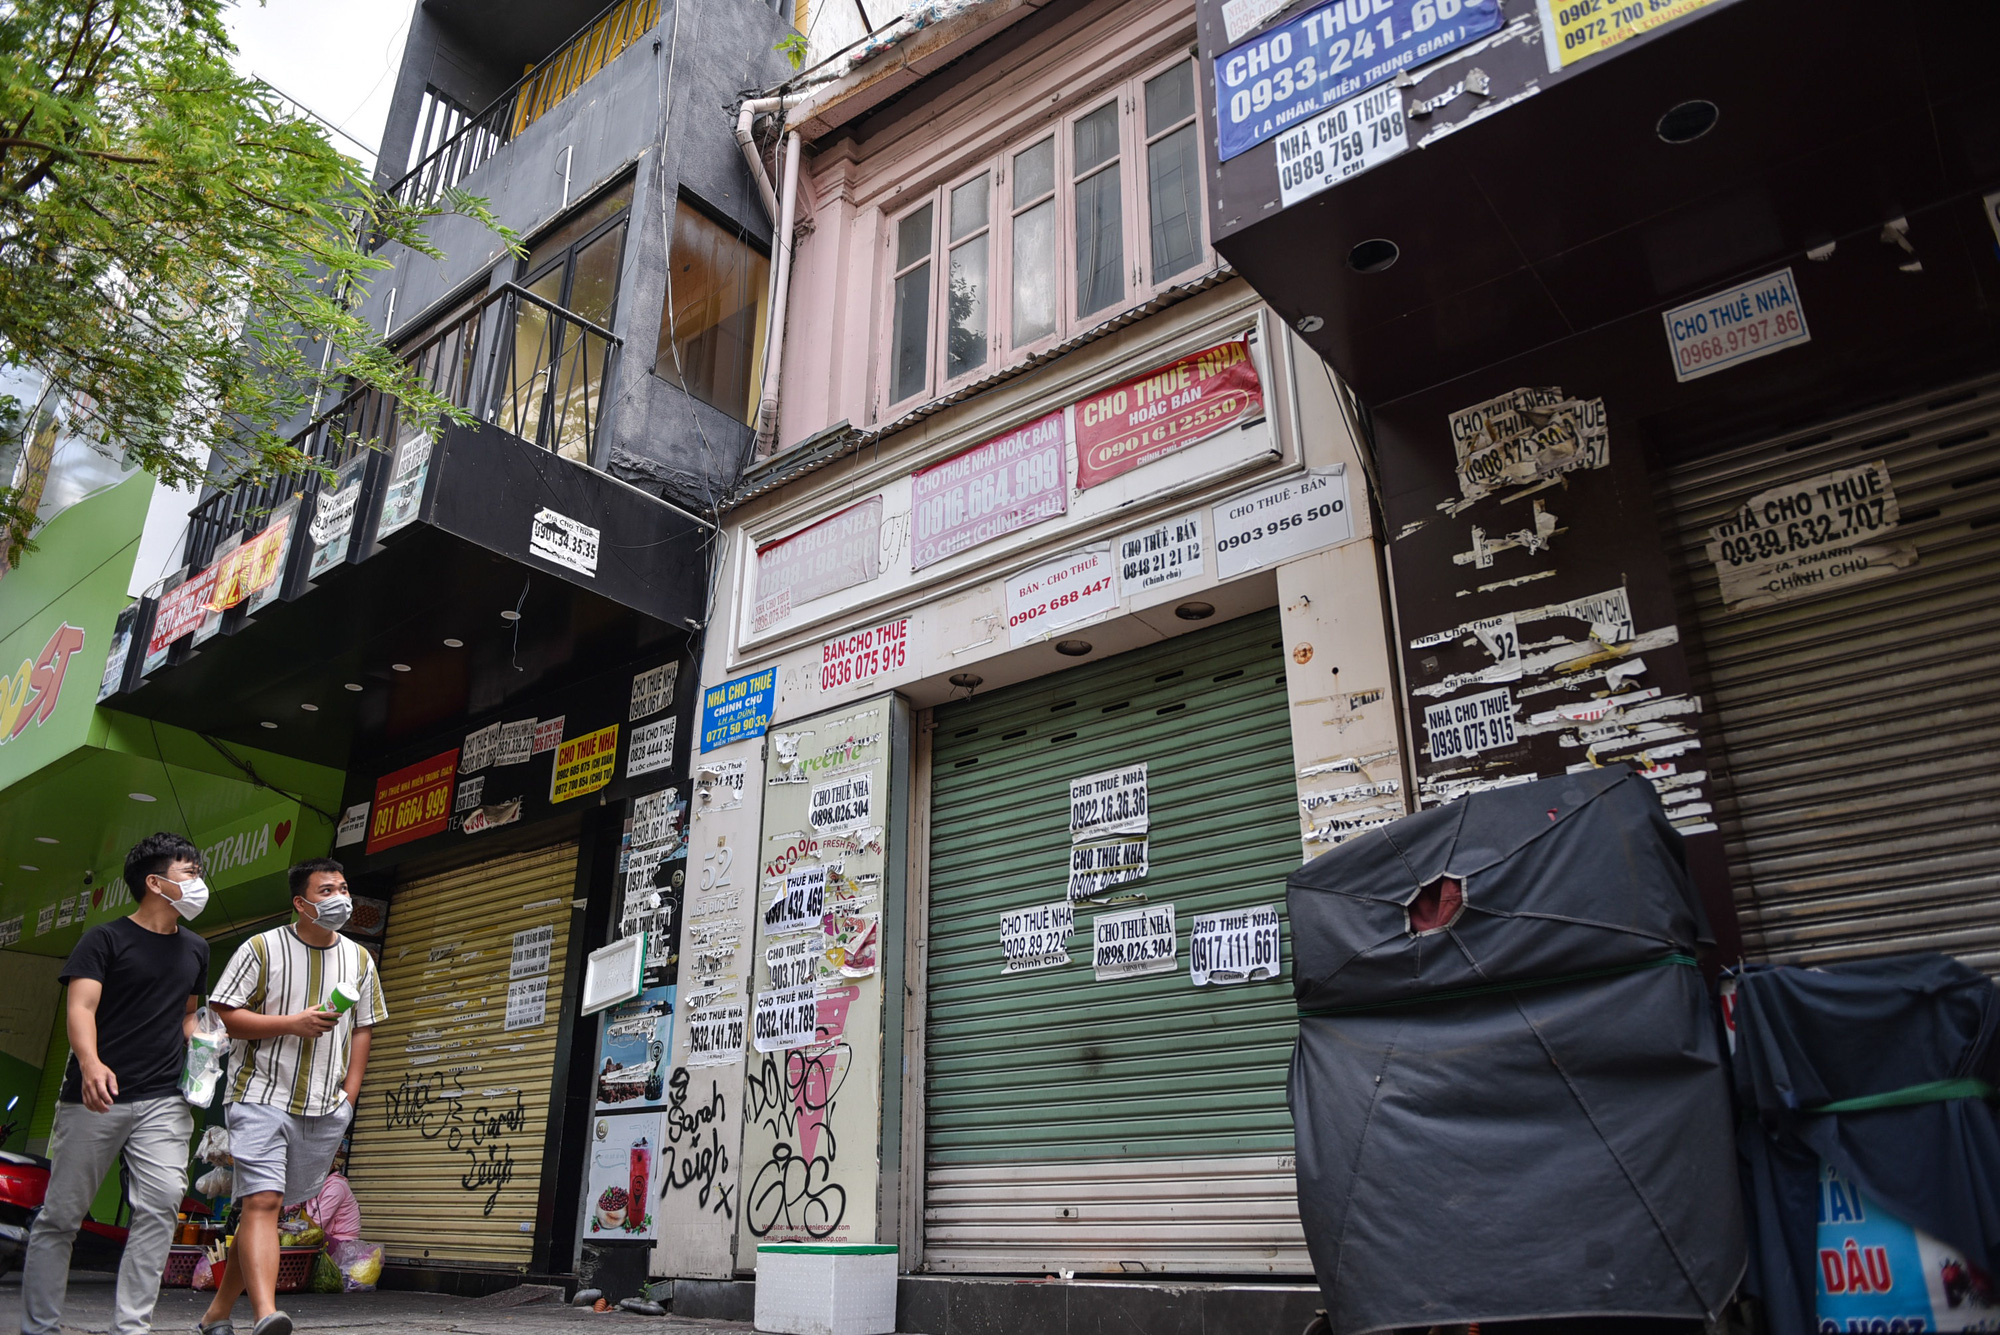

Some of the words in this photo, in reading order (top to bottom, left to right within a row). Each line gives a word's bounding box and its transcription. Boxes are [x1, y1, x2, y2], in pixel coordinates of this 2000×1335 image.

[1564, 18, 1608, 50] 0972
[1642, 3, 1697, 30] TRUNG
[1226, 31, 1293, 88] CHO
[1323, 76, 1361, 102] MIỄN
[1363, 54, 1414, 83] TRUNG
[1416, 35, 1455, 58] GIAN
[1279, 125, 1312, 164] NHÀ
[1317, 110, 1349, 146] CHO
[1353, 83, 1399, 125] THUÊ
[1281, 156, 1325, 192] 0989
[1329, 131, 1364, 168] 759
[1367, 111, 1405, 149] 798
[1674, 313, 1708, 342] CHO
[1709, 293, 1753, 330] THUÊ
[1757, 279, 1793, 312] NHÀ
[1680, 310, 1800, 368] 0968.9797.86
[1084, 390, 1128, 427] CHO
[1134, 360, 1191, 407] THUÊ
[1129, 400, 1168, 427] HOẶC
[1171, 386, 1202, 413] BÁN
[1099, 398, 1237, 462] 0901612550
[1453, 412, 1483, 442] CHO
[917, 473, 940, 495] CHO
[941, 456, 970, 485] THUÊ
[972, 442, 997, 476] NHÀ
[998, 431, 1031, 461] HOẶC
[1033, 419, 1058, 448] BÁN
[918, 447, 1059, 541] 0916.664.999
[1229, 503, 1254, 520] CHO
[1256, 487, 1291, 511] THUÊ
[1300, 477, 1327, 495] BÁN
[1764, 492, 1812, 525] CHO
[1817, 467, 1884, 510] THUÊ
[762, 544, 792, 570] CHO
[796, 518, 839, 557] THUÊ
[1122, 539, 1141, 560] CHO
[1143, 525, 1169, 552] THUÊ
[1176, 519, 1197, 544] BÁN
[1217, 528, 1263, 552] 0903
[1266, 513, 1303, 535] 956
[1307, 499, 1344, 521] 500
[1019, 581, 1040, 598] BÁN
[1047, 570, 1068, 586] CHO
[1070, 555, 1099, 576] THUÊ
[1123, 561, 1150, 581] 0848
[1152, 555, 1165, 572] 21
[1169, 548, 1182, 567] 21
[1187, 542, 1200, 561] 12
[1769, 568, 1825, 593] CHÍNH
[1829, 555, 1869, 578] CHỦ
[1142, 574, 1165, 589] (Chính
[1009, 603, 1047, 628] 0902
[1050, 590, 1079, 611] 688
[1082, 576, 1112, 597] 447
[822, 658, 852, 690] 0936
[855, 649, 879, 680] 075
[882, 640, 906, 672] 915
[823, 630, 873, 663] BÁN-CHO
[632, 677, 645, 700] CHO
[707, 686, 726, 709] NHÀ
[728, 681, 747, 701] CHO
[750, 669, 773, 694] THUÊ
[714, 700, 742, 717] CHÍNH
[745, 692, 763, 707] CHỦ
[706, 726, 728, 743] 0777
[730, 721, 742, 735] 50
[743, 717, 754, 731] 90
[755, 714, 767, 727] 33
[1429, 704, 1452, 730] NHÀ
[1455, 705, 1478, 725] CHO
[1481, 690, 1510, 718] THUÊ
[559, 744, 574, 766] CHO
[577, 733, 597, 760] THUÊ
[598, 727, 616, 753] NHÀ
[632, 727, 645, 745] NHÀ
[645, 729, 658, 742] CHO
[659, 719, 675, 736] THUÊ
[1431, 727, 1462, 759] 0936
[1464, 720, 1488, 751] 075
[1490, 716, 1515, 746] 915
[814, 788, 831, 808] CHO
[831, 778, 852, 804] THUÊ
[852, 775, 869, 799] NHÀ
[1072, 783, 1092, 799] CHO
[1095, 774, 1120, 794] THUÊ
[1122, 767, 1144, 786] NHÀ
[374, 805, 394, 837] 091
[425, 786, 448, 819] 999
[811, 798, 869, 826] 0898.026.304
[1072, 786, 1145, 831] 0922.16.36.36
[629, 856, 642, 869] CHO
[700, 846, 733, 892] 52
[1073, 849, 1093, 871] CHO
[1096, 842, 1121, 868] THUÊ
[787, 872, 806, 888] THUÊ
[624, 918, 636, 937] CHO
[1001, 916, 1021, 936] CHO
[1024, 906, 1049, 932] THUÊ
[1051, 902, 1072, 928] NHÀ
[1098, 923, 1119, 943] CHO
[1119, 912, 1148, 939] THUÊ
[1149, 909, 1171, 935] NHÀ
[1193, 920, 1215, 935] CHO
[1219, 913, 1248, 931] THUÊ
[768, 947, 784, 961] CHO
[786, 941, 806, 957] THUÊ
[1010, 958, 1041, 970] Chính
[1097, 936, 1173, 967] 0898.026.304
[1192, 928, 1277, 972] 0917.111.661
[692, 1012, 706, 1022] CHO
[708, 1007, 726, 1021] THUÊ
[728, 1004, 743, 1018] NHÀ
[758, 997, 774, 1008] CHO
[776, 990, 796, 1005] THUÊ
[798, 986, 814, 1002] NHÀ
[756, 1003, 815, 1039] 0932.141.789
[1819, 1239, 1892, 1293] DÂU
